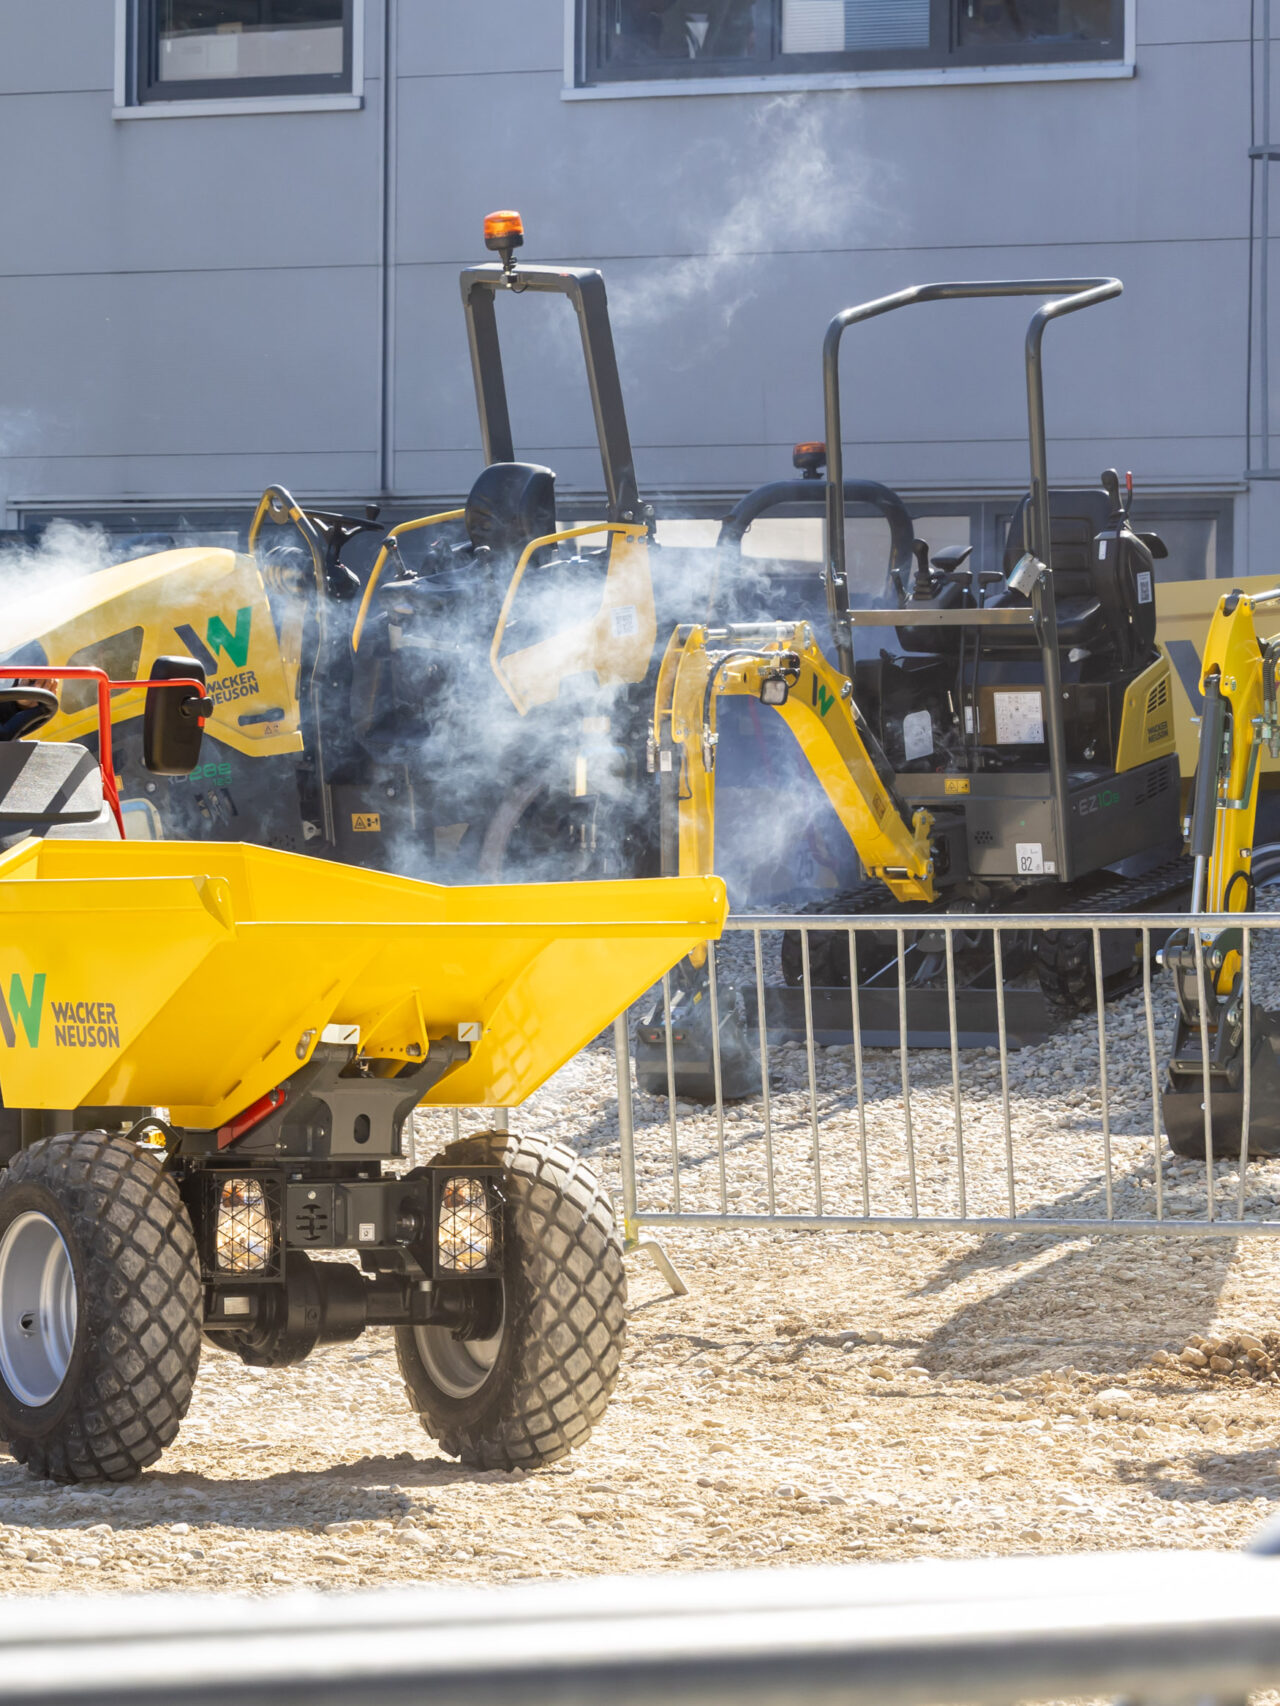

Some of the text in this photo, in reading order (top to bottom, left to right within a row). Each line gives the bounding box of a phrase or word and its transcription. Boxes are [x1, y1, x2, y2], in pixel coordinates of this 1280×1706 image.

[205, 670, 257, 695] WACKER
[1020, 856, 1033, 871] 82
[51, 1002, 118, 1024] WACKER
[54, 1025, 120, 1048] NEUSON
